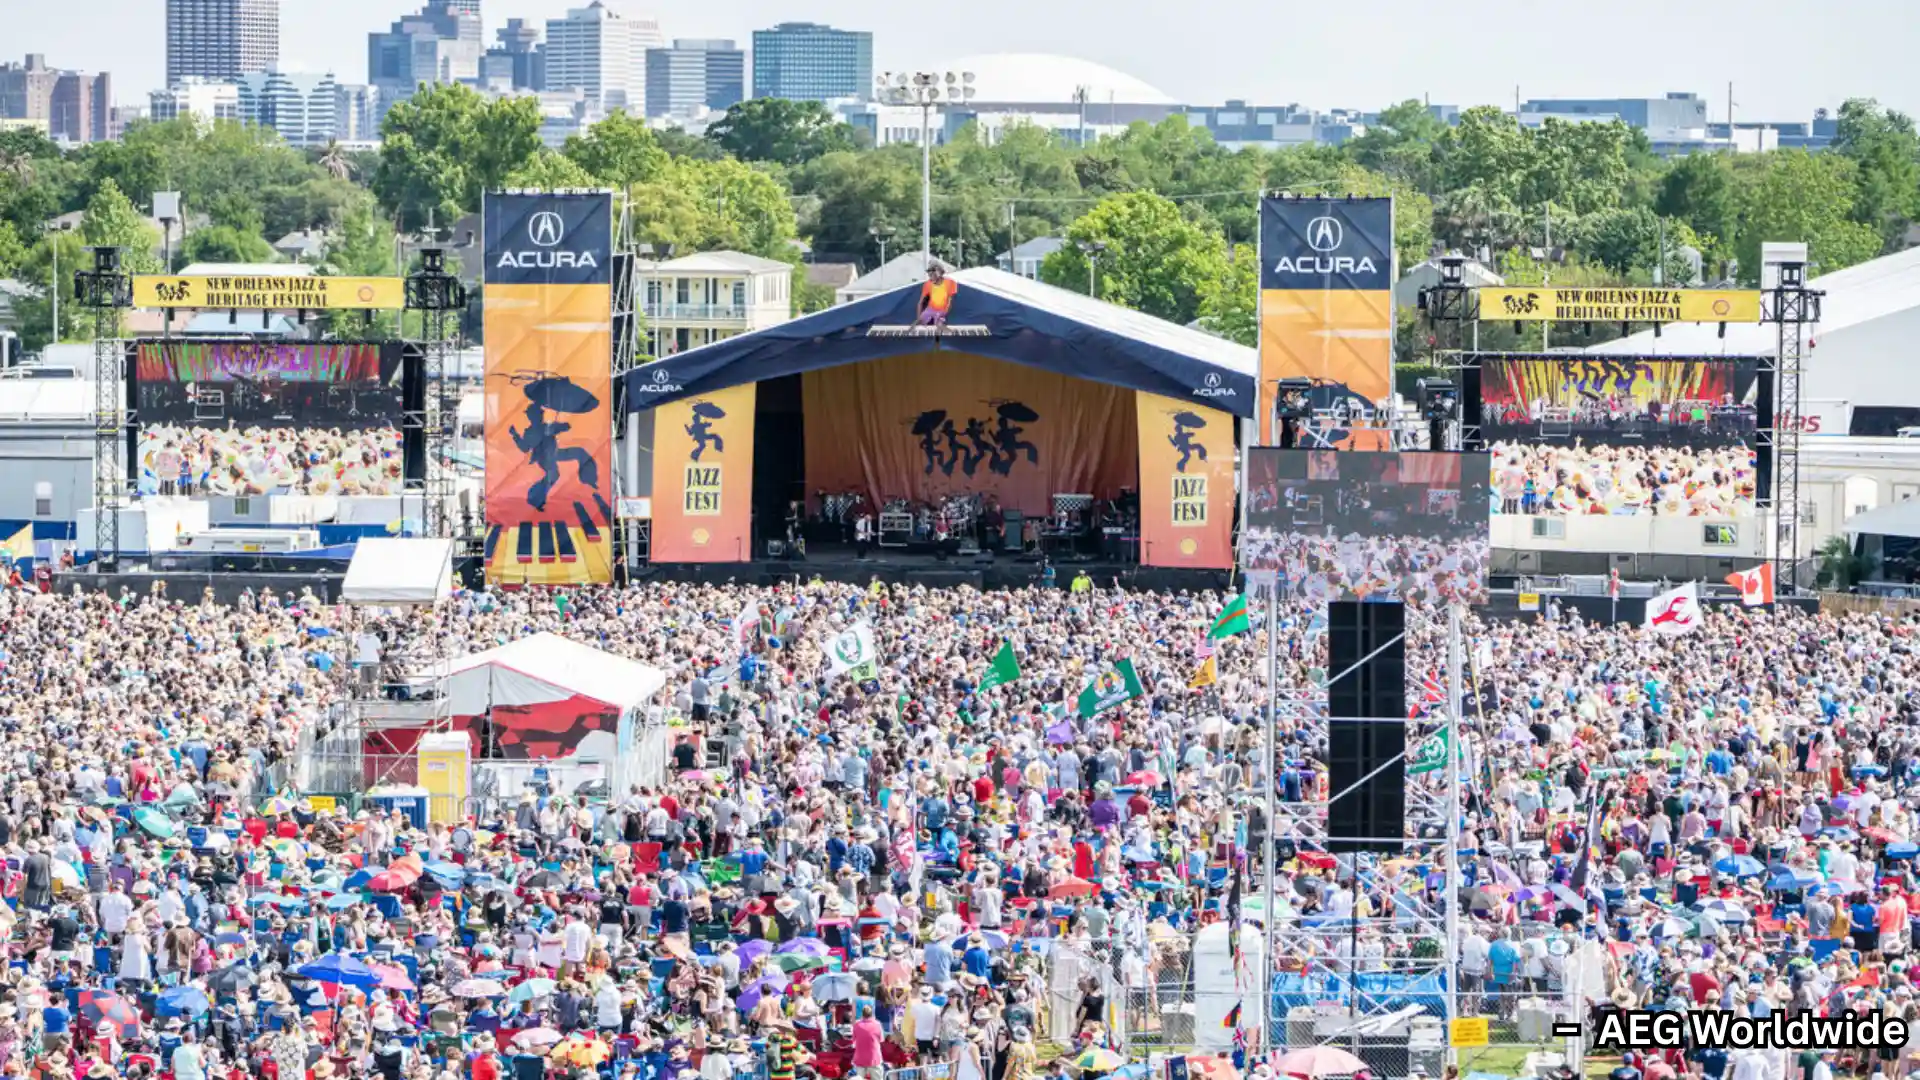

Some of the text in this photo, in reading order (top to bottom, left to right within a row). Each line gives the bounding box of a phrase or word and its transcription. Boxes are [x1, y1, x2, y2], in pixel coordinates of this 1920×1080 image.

[496, 251, 598, 268] ACURA
[1274, 256, 1378, 273] ACURA
[206, 277, 328, 292] NEW ORLEANS JAZZ &
[206, 293, 329, 307] HERITAGE FESTIVAL
[1556, 290, 1681, 305] NEW ORLEANS JAZZ &
[1556, 306, 1682, 320] HERITAGE FESTIVAL
[640, 384, 684, 392] ACURA
[1192, 387, 1237, 397] ACURA
[686, 467, 721, 489] JAZZ
[1173, 478, 1206, 500] JAZZ
[686, 491, 721, 510] FEST
[1174, 502, 1206, 521] FEST
